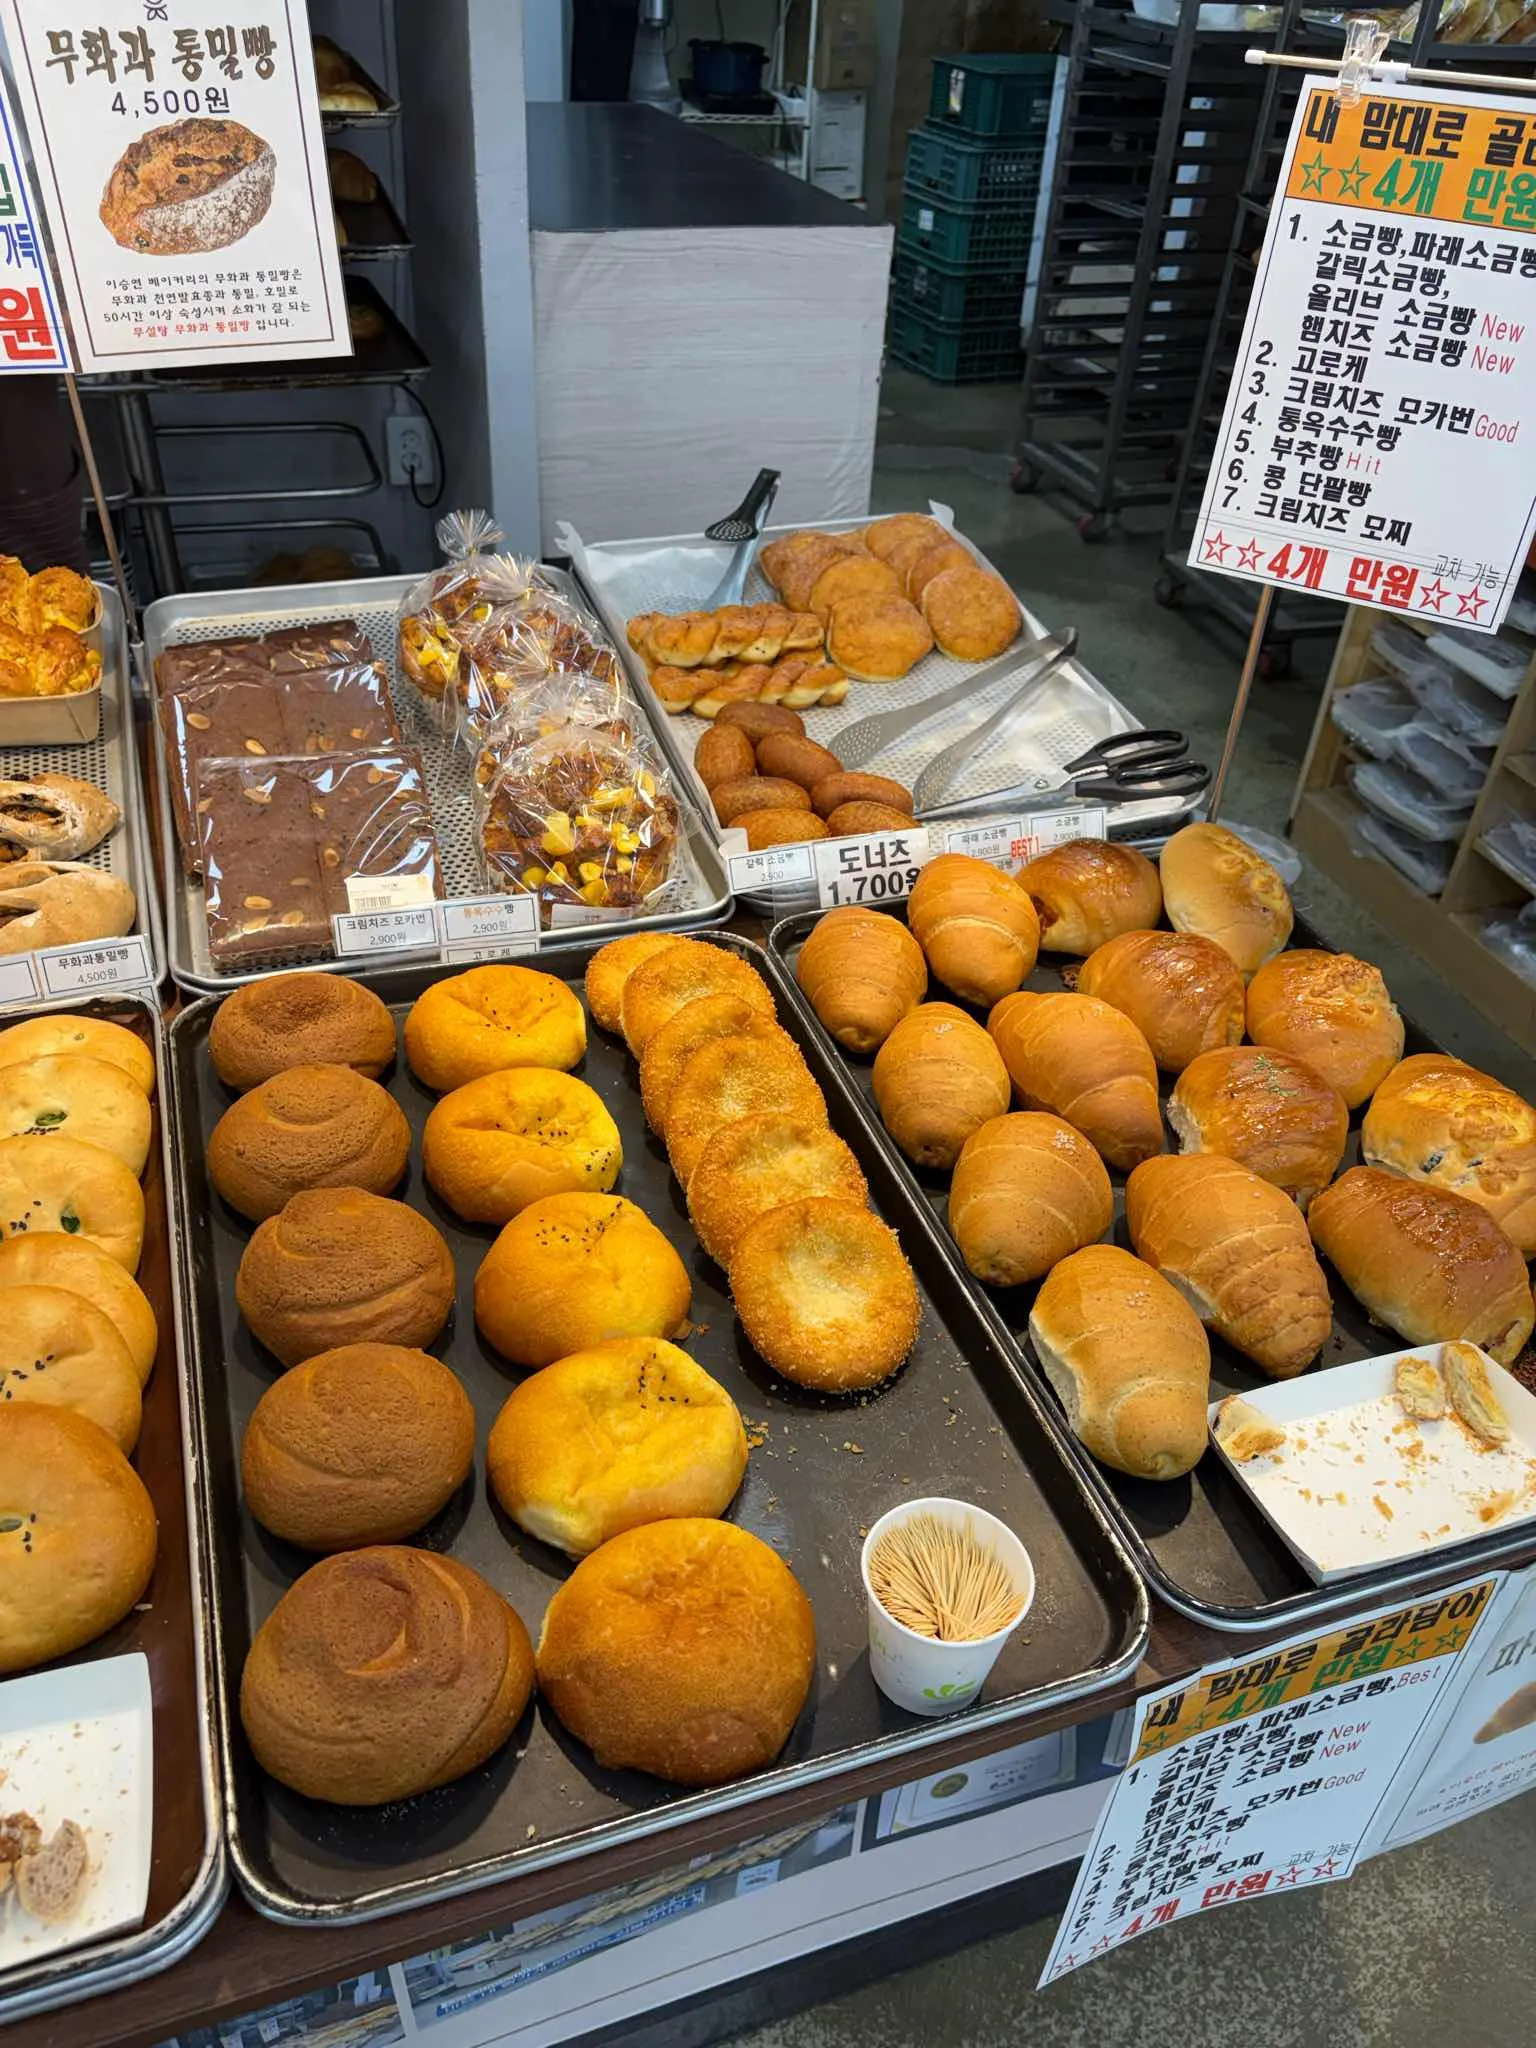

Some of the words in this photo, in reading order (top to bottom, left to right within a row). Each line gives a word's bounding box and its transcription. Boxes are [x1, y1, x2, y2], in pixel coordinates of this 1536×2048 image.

[46, 26, 155, 84] 무화과
[171, 25, 277, 80] 통밀빵
[111, 87, 230, 118] 4,500원
[1305, 95, 1341, 144] 내
[1360, 101, 1468, 159] 맘대로
[1372, 158, 1444, 215] 4개
[1463, 168, 1536, 229] 만원
[1289, 214, 1308, 242] 1.
[105, 278, 142, 291] 이승연
[215, 271, 249, 284] 무화과
[256, 268, 302, 282] 통밀빵은
[112, 293, 146, 306] 무화과
[265, 285, 298, 297] 호밀로
[1316, 251, 1450, 300] 갈릭소금빵,
[104, 311, 143, 323] 50시간
[150, 308, 173, 320] 이상
[179, 306, 226, 319] 숙성시켜
[232, 303, 266, 315] 소화가
[272, 303, 283, 314] 잘
[288, 301, 311, 312] 되는
[133, 325, 167, 337] 무설탕
[175, 322, 209, 334] 무화과
[216, 320, 250, 333] 통밀빵
[1307, 283, 1384, 321] 올리브
[1393, 298, 1477, 336] 소금빵
[1480, 313, 1526, 343] New
[1255, 340, 1277, 367] 2.
[1291, 346, 1368, 383] 고로케
[1300, 314, 1375, 352] 햄치즈
[1385, 330, 1467, 367] 소금빵
[1471, 345, 1516, 375] New
[1240, 402, 1262, 427] 4.
[1277, 406, 1402, 452] 통옥수수빵
[1249, 370, 1270, 397] 3.
[1284, 377, 1384, 418] 크림치즈
[1394, 397, 1475, 434] 모카번
[1475, 413, 1520, 444] Good
[1234, 430, 1255, 455] 5.
[1271, 435, 1343, 472] 부추빵
[1346, 452, 1382, 476] Hit
[1227, 458, 1248, 484] 6.
[1264, 464, 1287, 491] 콩
[1299, 471, 1372, 508] 단팥빵
[1221, 485, 1241, 512] 7.
[1254, 492, 1350, 534] 크림치즈
[1359, 515, 1413, 546] 모찌
[1267, 543, 1329, 590] 4개
[1346, 556, 1420, 609] 만원
[1431, 555, 1464, 579] 교차
[1473, 562, 1507, 589] 가능
[983, 828, 1008, 841] 소금빵
[1055, 816, 1080, 827] 소금빵
[839, 839, 912, 874] 도너츠
[1011, 838, 1034, 858] BEST
[346, 917, 391, 930] 크림치즈
[393, 913, 425, 926] 모카번
[463, 903, 514, 918] 통옥수수빵
[472, 920, 508, 934] 2,900원
[58, 949, 129, 969] 무화과통밀빵
[369, 932, 407, 945] 2,900원
[77, 968, 118, 984] 4,500원
[1149, 1693, 1185, 1728] 내
[1206, 1644, 1318, 1706] 맘대로
[1336, 1586, 1486, 1658] 골라담아
[1218, 1676, 1293, 1721] 4개
[1310, 1640, 1393, 1694] 만원
[1129, 1768, 1148, 1786] 1.
[1151, 1762, 1229, 1806] 올리브
[1241, 1730, 1324, 1770] 소금빵
[1328, 1721, 1371, 1742] New
[1159, 1724, 1296, 1787] 갈릭소금빵,
[1145, 1780, 1221, 1824] 햄치즈
[1232, 1750, 1315, 1788] 소금빵
[1319, 1740, 1361, 1760] New
[1092, 1863, 1114, 1881] 3.
[1130, 1806, 1232, 1861] 크림치즈
[1243, 1778, 1323, 1813] 모카번
[1324, 1768, 1367, 1790] Good
[1098, 1844, 1120, 1863] 2.
[1136, 1798, 1215, 1843] 고로케
[1071, 1927, 1089, 1944] 7.
[1212, 1851, 1264, 1878] 모찌
[1081, 1896, 1101, 1913] 5.
[1087, 1880, 1108, 1897] 4.
[1120, 1898, 1181, 1938] 4개
[1201, 1870, 1273, 1908] 만원
[1075, 1913, 1095, 1928] 6.
